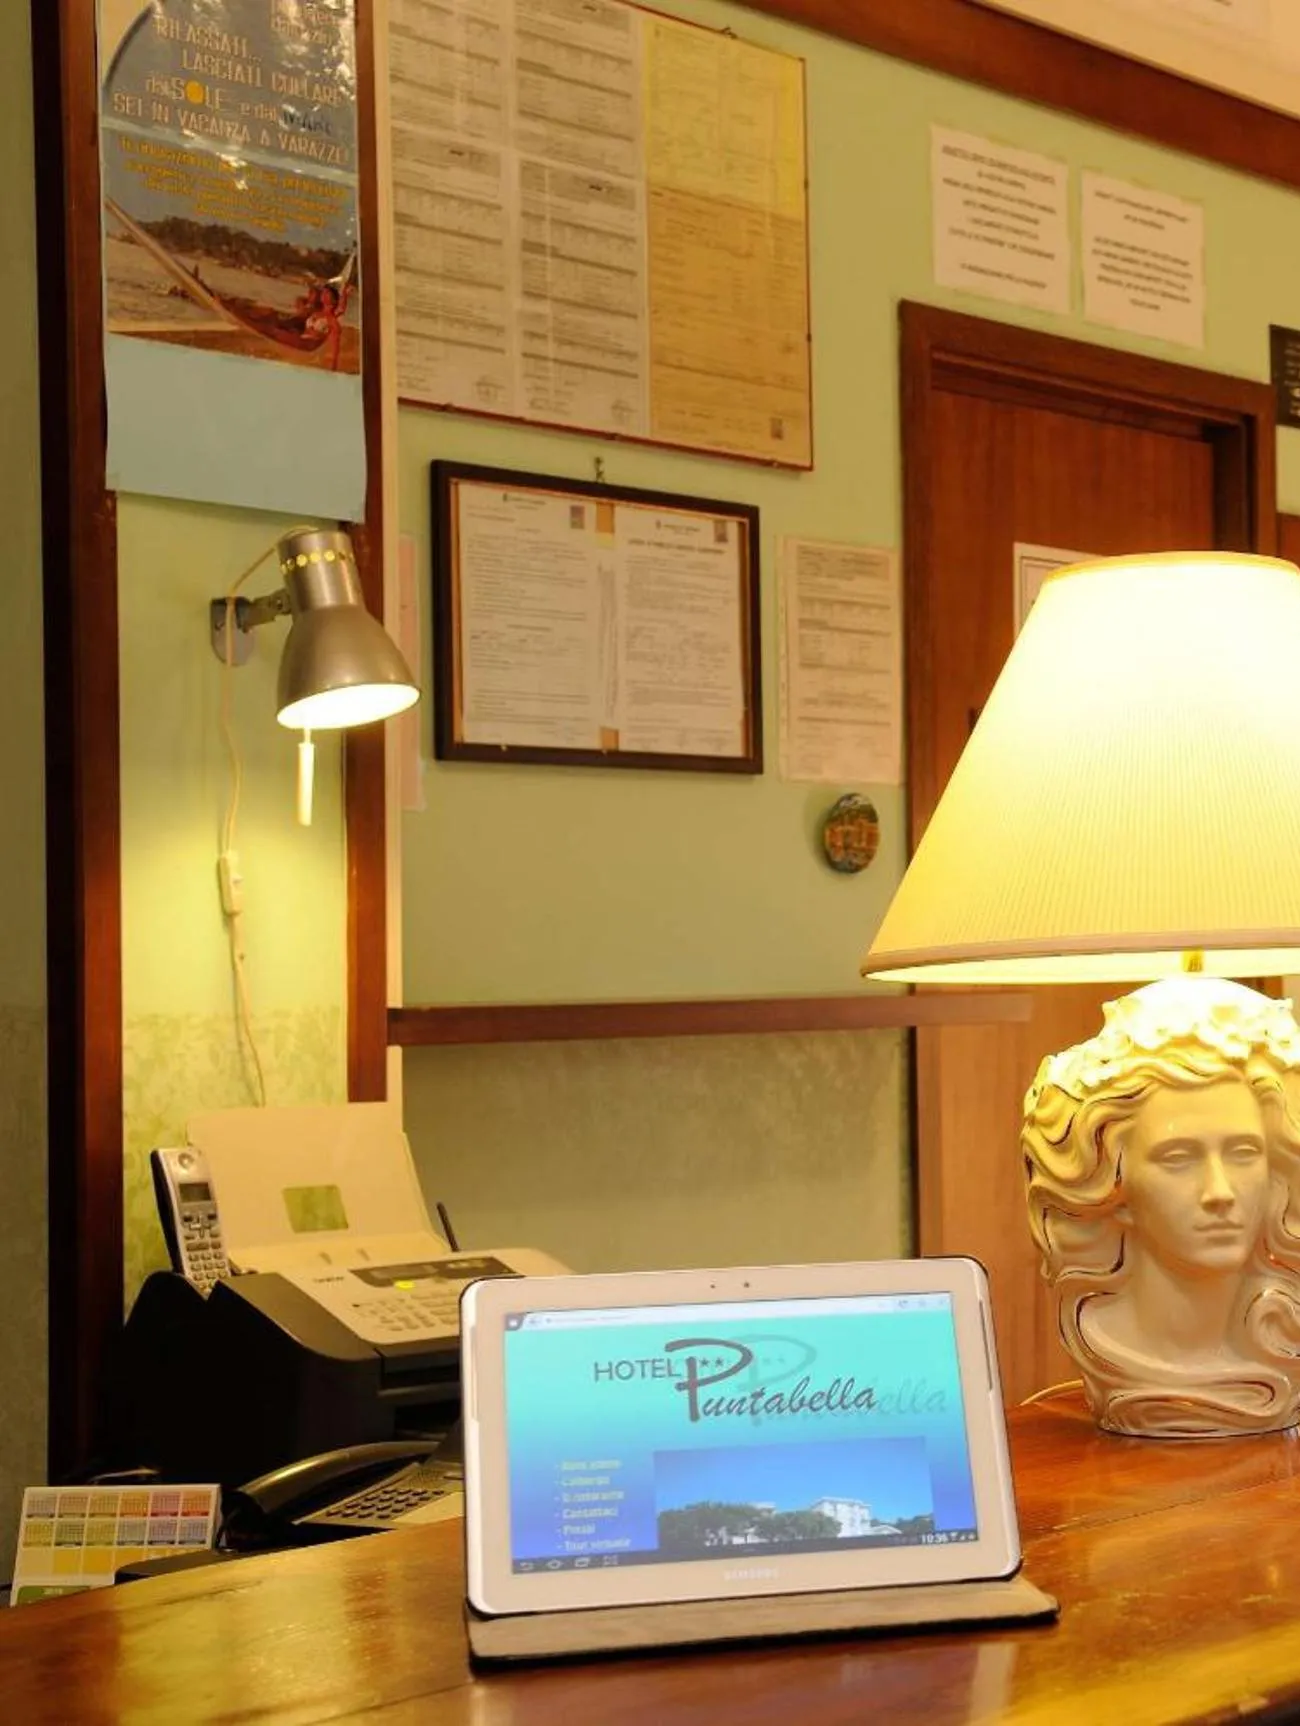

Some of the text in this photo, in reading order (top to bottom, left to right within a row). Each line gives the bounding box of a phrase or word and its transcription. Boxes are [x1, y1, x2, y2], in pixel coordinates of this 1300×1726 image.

[114, 92, 142, 117] SEI
[152, 101, 169, 123] IN
[177, 107, 251, 144] VACANZA
[260, 128, 271, 146] A
[594, 1357, 682, 1383] HOTEL
[664, 1338, 878, 1423] Puntabella
